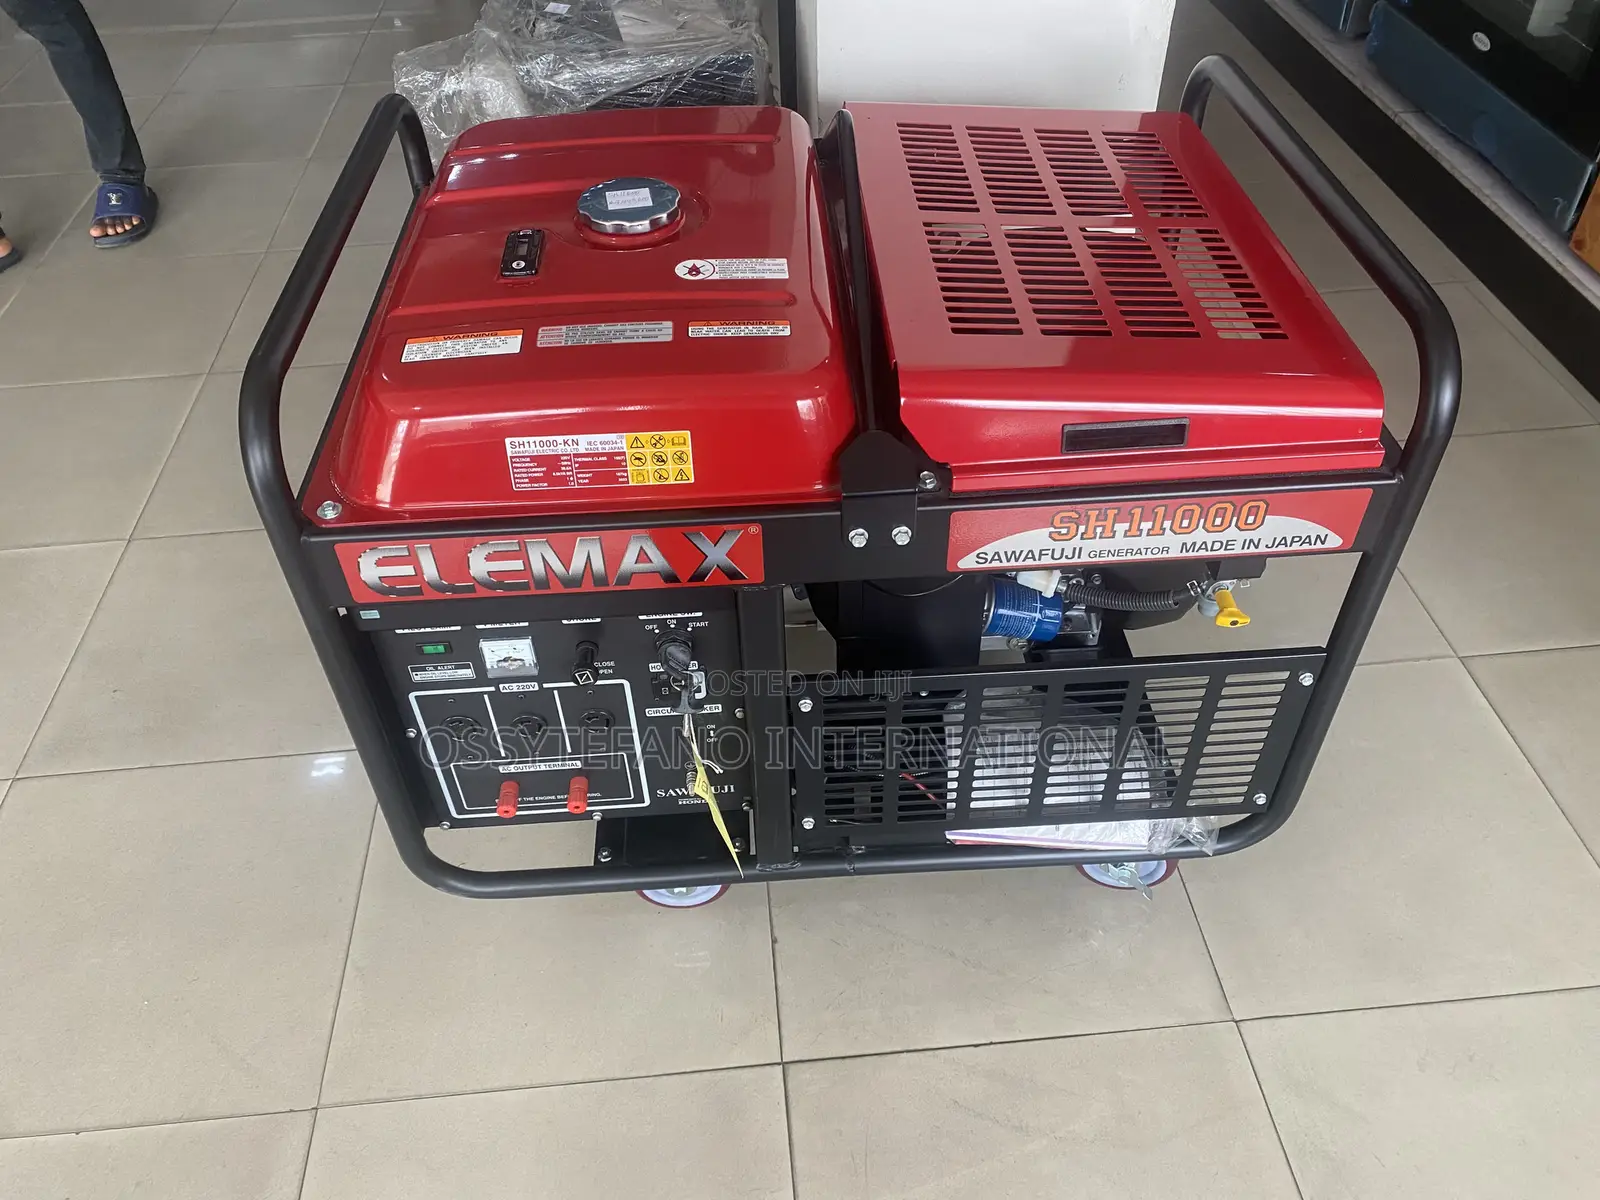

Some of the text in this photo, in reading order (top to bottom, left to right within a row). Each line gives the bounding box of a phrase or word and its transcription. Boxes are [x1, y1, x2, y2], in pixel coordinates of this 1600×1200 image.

[443, 332, 498, 341] WARNING
[510, 438, 579, 449] SH11000-KN
[1048, 499, 1270, 541] SH11000
[974, 534, 1328, 565] SAWAFUJI GENERATOR MADE IN JAPAN
[358, 528, 749, 597] ELEMAX
[514, 763, 542, 771] OUTPUT
[544, 761, 580, 770] TERMINAL
[657, 784, 735, 797] SAWUJI
